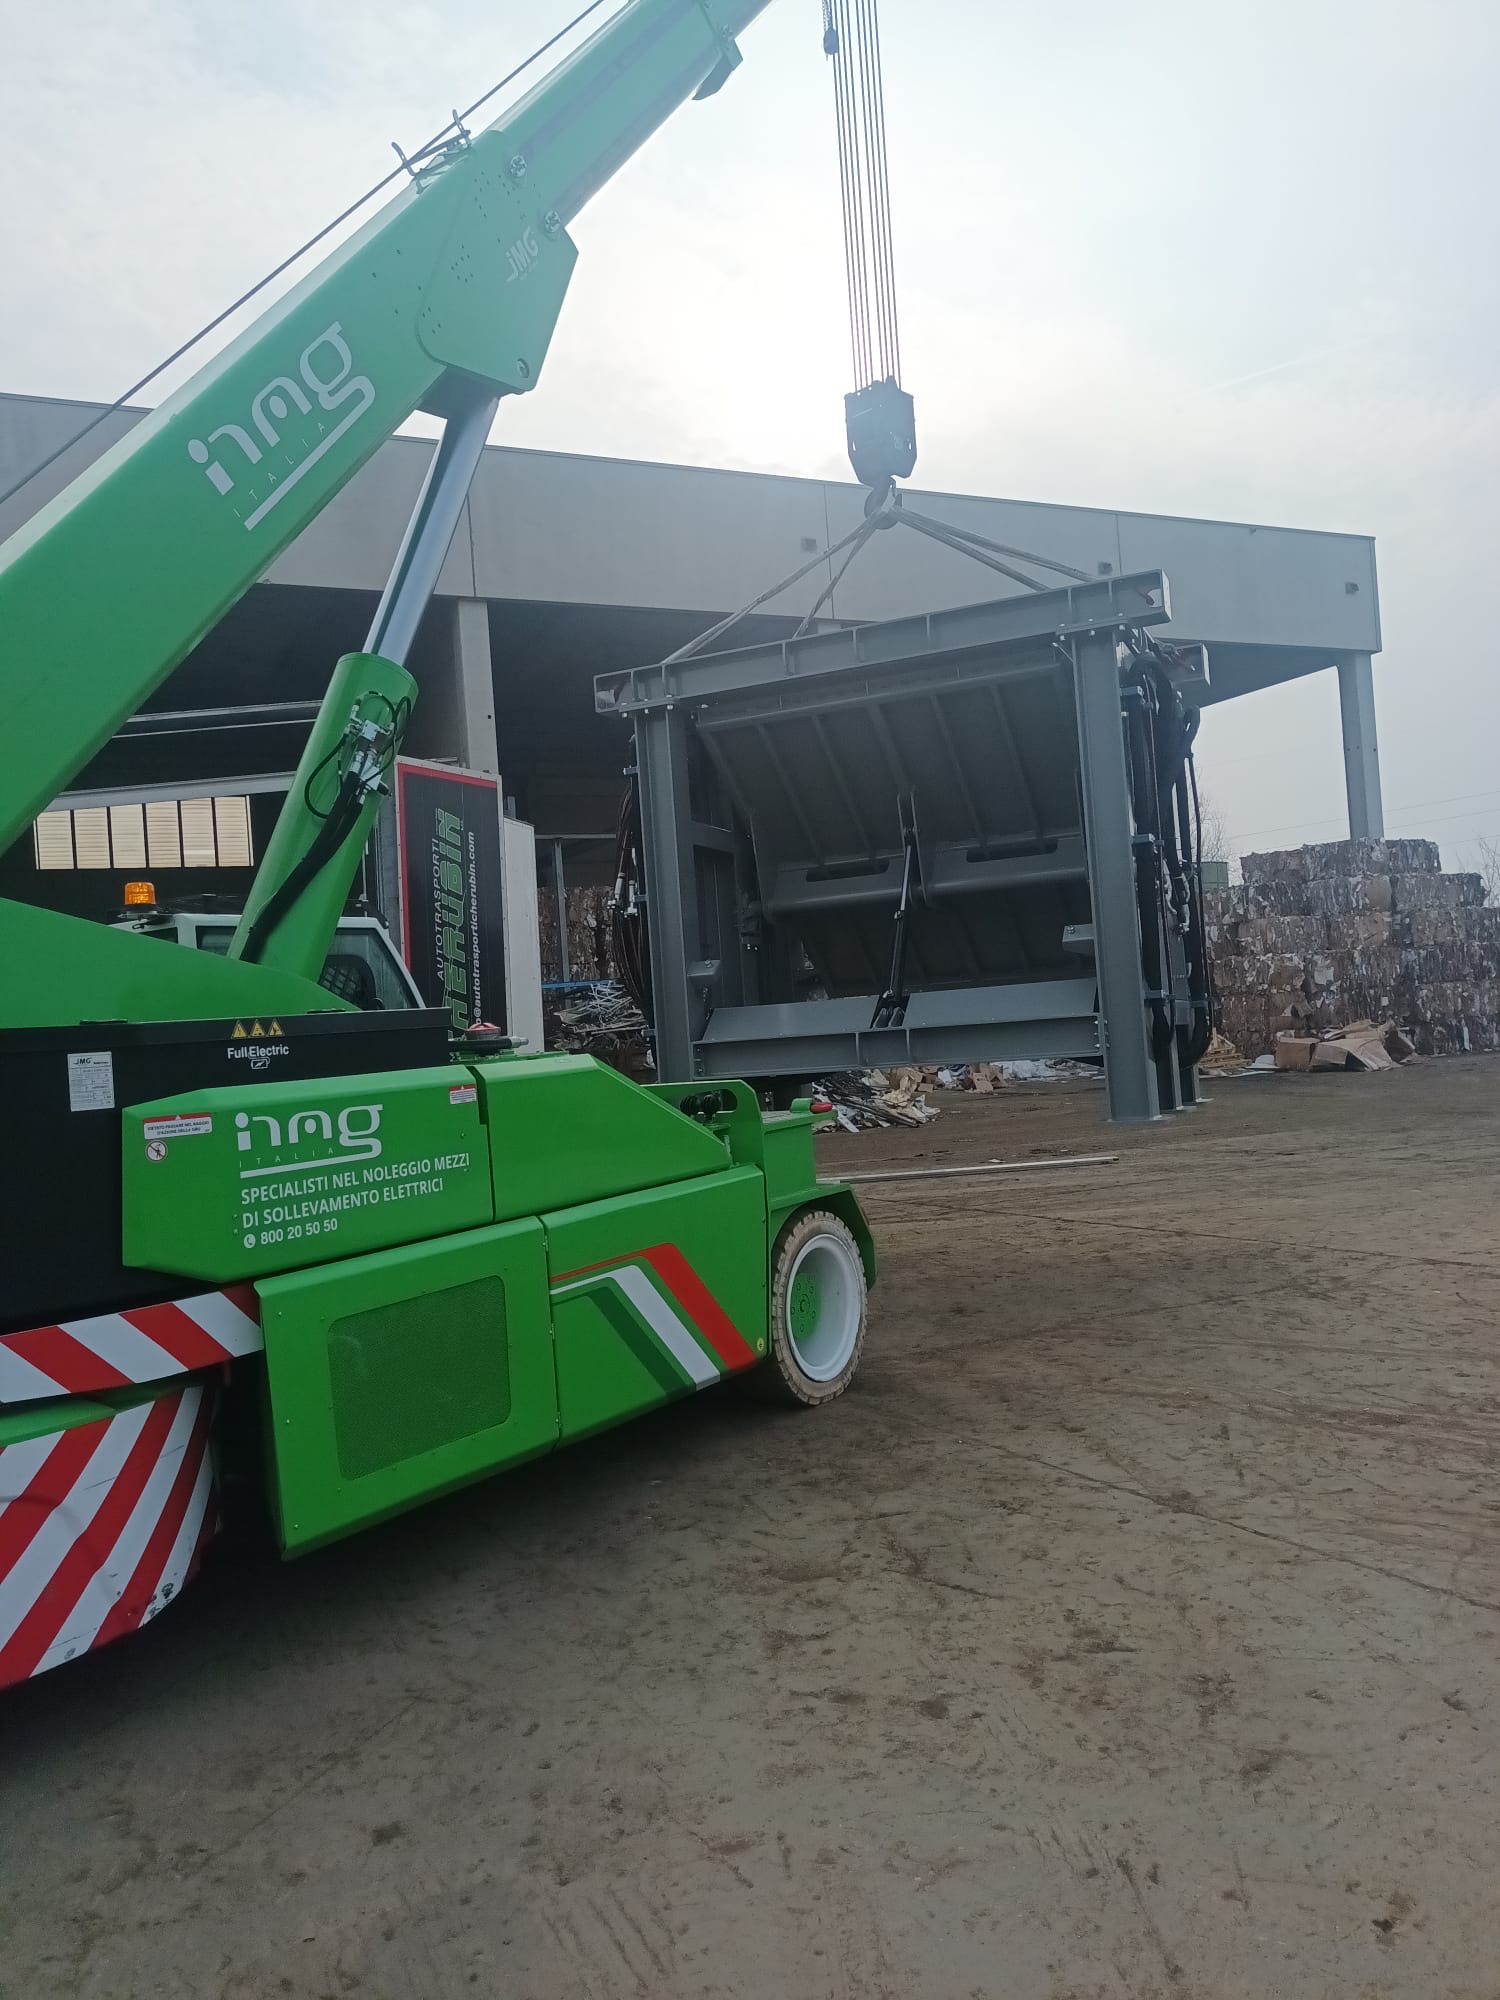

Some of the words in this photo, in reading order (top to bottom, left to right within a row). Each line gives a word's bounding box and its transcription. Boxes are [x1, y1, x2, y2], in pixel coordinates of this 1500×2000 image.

[233, 421, 326, 519] ITALIA
[432, 838, 445, 981] AUTOTRASPORTI
[437, 808, 468, 1040] HERUBIN
[468, 831, 482, 1025] o@autotrasporticherubin.com
[239, 1147, 334, 1169] ITALIA
[241, 1177, 328, 1205] SPECIALISTI
[333, 1171, 360, 1189] NEL
[363, 1159, 432, 1184] NOLEGGIO
[434, 1152, 470, 1171] MEZZI
[242, 1212, 259, 1229] DI
[263, 1189, 380, 1225] SOLLEVAMENTO
[383, 1178, 443, 1202] ELETTRICI
[260, 1228, 284, 1245] 800
[287, 1225, 303, 1240] 20
[305, 1221, 320, 1236] 50
[323, 1218, 338, 1233] 50
